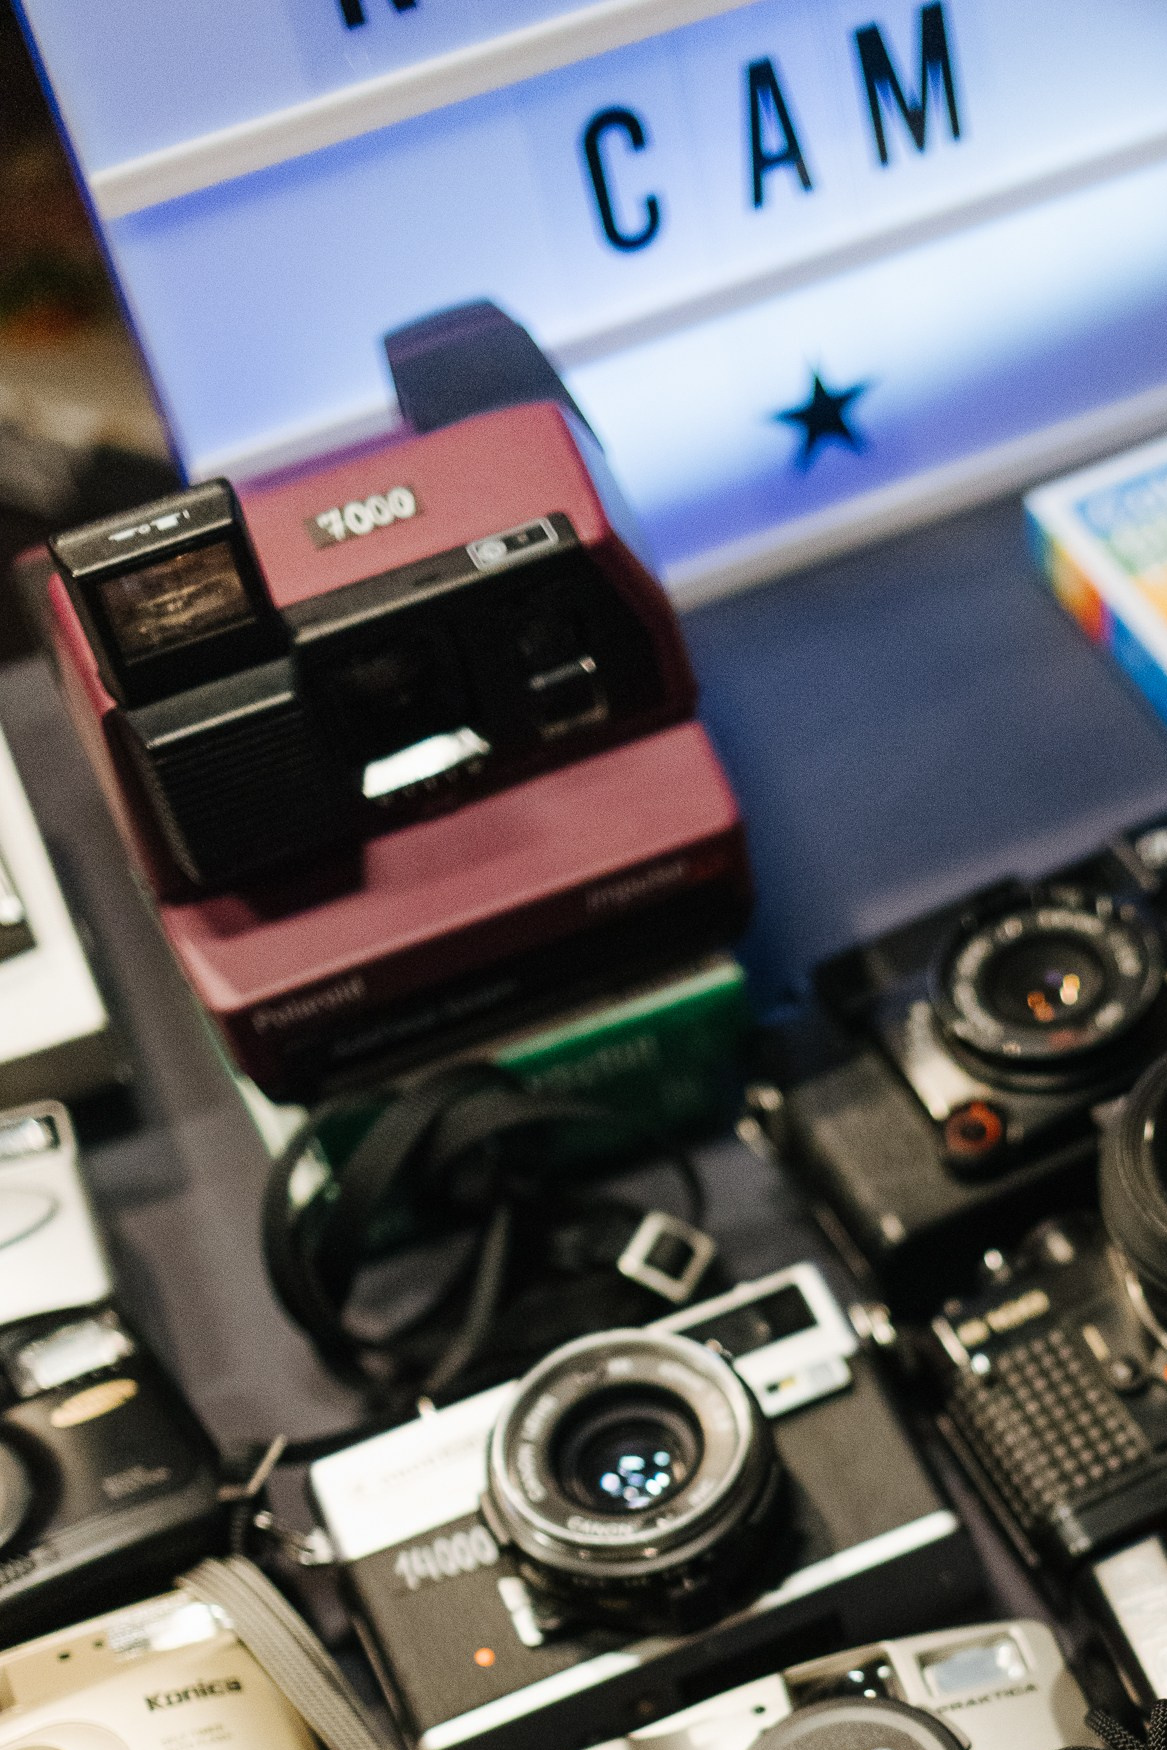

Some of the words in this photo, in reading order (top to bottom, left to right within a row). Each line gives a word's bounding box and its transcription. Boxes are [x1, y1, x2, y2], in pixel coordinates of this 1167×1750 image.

[313, 485, 418, 543] 7000
[393, 1524, 500, 1591] 14000
[144, 1675, 243, 1712] Konica
